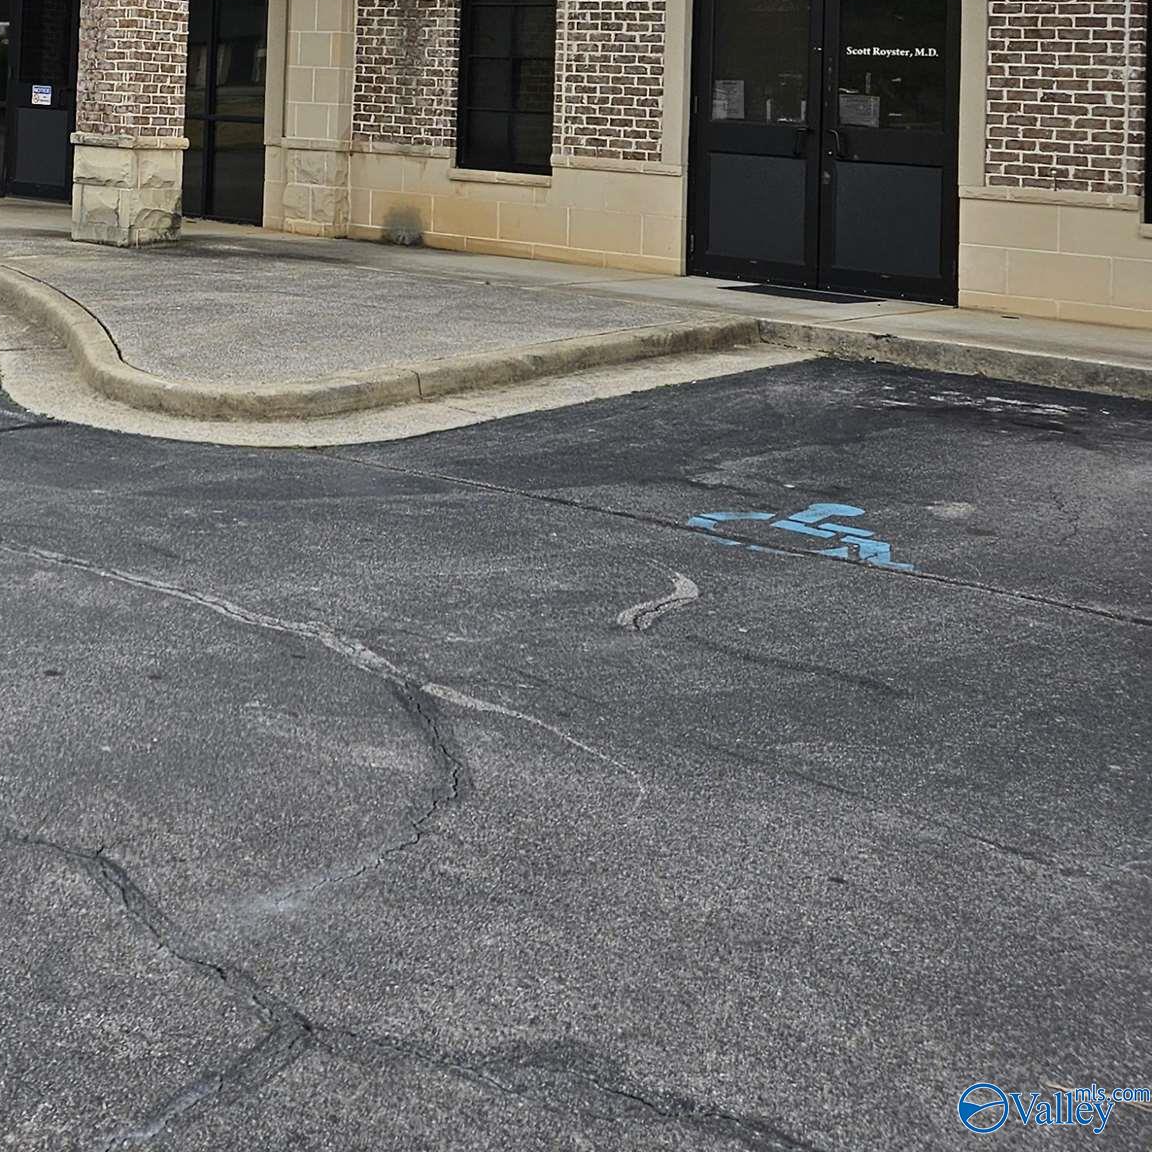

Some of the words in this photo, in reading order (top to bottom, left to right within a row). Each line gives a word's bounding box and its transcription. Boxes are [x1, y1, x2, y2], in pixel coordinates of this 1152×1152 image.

[846, 46, 871, 56] Scott
[872, 46, 913, 58] Royster,
[914, 47, 939, 57] M.D.
